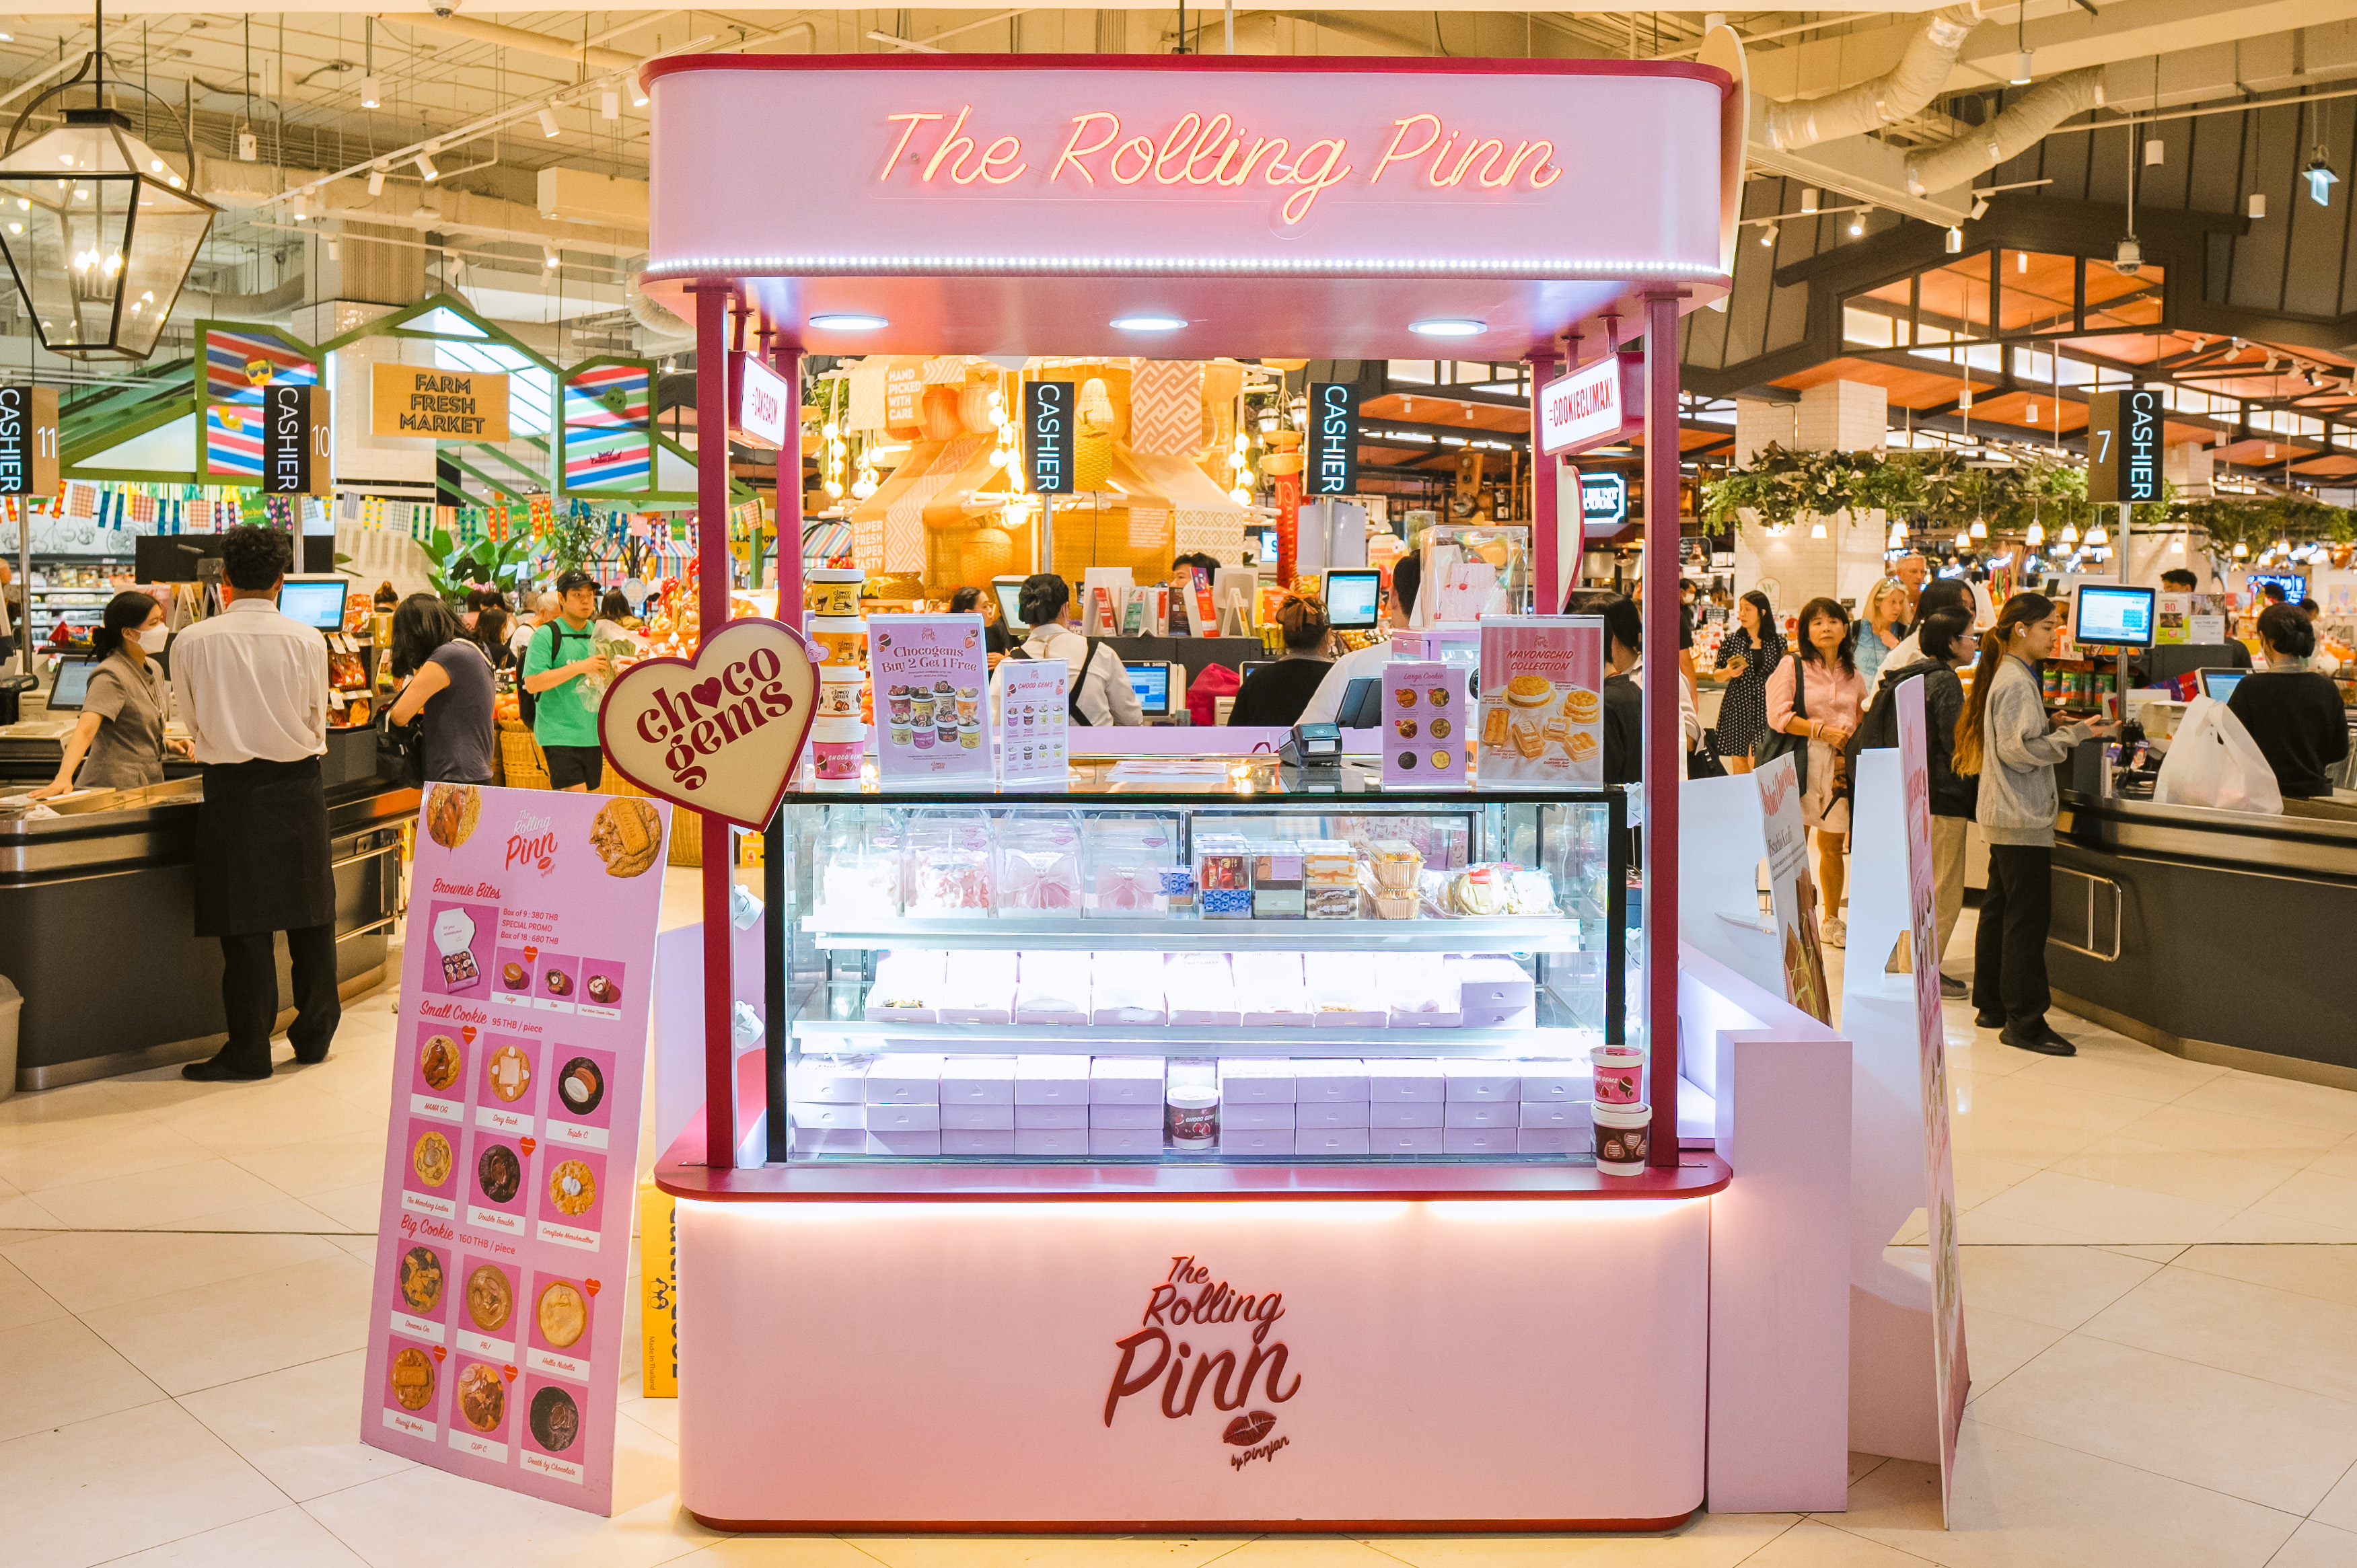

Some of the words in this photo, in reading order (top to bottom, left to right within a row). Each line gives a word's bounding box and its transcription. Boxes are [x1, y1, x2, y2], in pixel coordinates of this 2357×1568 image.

[880, 103, 1027, 184] The
[1049, 110, 1352, 226] Rolling
[1371, 112, 1562, 188] Pinn
[889, 369, 915, 381] HAND
[415, 374, 470, 394] FARM
[889, 380, 921, 395] PICKED
[410, 394, 476, 414] FRESH
[889, 396, 911, 408] WITH
[889, 407, 913, 420] CARE
[399, 413, 485, 434] MARKET
[0, 388, 22, 492] CASHIER
[37, 426, 56, 459] 11
[277, 387, 298, 492] CASHIER
[312, 424, 330, 457] 10
[1036, 383, 1060, 491] CASHIER
[1321, 385, 1348, 493] CASHIER
[2097, 429, 2111, 463] 7
[2130, 392, 2153, 499] CASHIER
[853, 521, 883, 534] SUPER
[854, 533, 883, 546] FRESH
[854, 545, 883, 558] SUPER
[855, 557, 883, 570] TASTY
[2165, 603, 2175, 611] 80
[894, 645, 964, 658] Chocogems
[1506, 650, 1574, 659] MAYONGCHID
[881, 661, 905, 673] Buy
[908, 658, 916, 669] 2
[919, 657, 939, 667] Get
[943, 659, 947, 667] 1
[950, 658, 977, 672] Free
[1510, 662, 1570, 671] COLLECTION
[1404, 673, 1422, 683] Large
[665, 681, 793, 790] gems
[519, 809, 530, 819] The
[513, 816, 552, 835] Rolling
[505, 832, 558, 871] Pinn
[432, 877, 474, 897] Brownie
[476, 882, 501, 899] Bites
[503, 908, 514, 916] Box
[515, 909, 523, 917] of
[531, 911, 544, 920] 380
[545, 913, 558, 921] THB
[502, 920, 527, 930] SPECIAL
[528, 923, 552, 932] PROMO
[501, 931, 512, 939] Box
[532, 934, 544, 942] 680
[545, 936, 558, 944] THB
[419, 999, 450, 1019] Small
[452, 1006, 487, 1024] Cookie
[492, 1017, 502, 1026] 95
[502, 1018, 517, 1029] THB
[523, 1022, 543, 1033] piece
[424, 1103, 439, 1113] MAMA
[493, 1114, 504, 1126] Sexy
[505, 1117, 518, 1125] Back
[567, 1128, 582, 1140] Triple
[583, 1131, 589, 1139] C
[478, 1212, 496, 1223] Double
[497, 1215, 515, 1227] Trouble
[400, 1214, 416, 1238] Big
[420, 1218, 454, 1240] Cookie
[459, 1233, 472, 1244] 160
[474, 1236, 489, 1248] THB
[495, 1242, 516, 1255] piece
[1168, 1255, 1210, 1284] The
[1143, 1281, 1286, 1345] Rolling
[542, 1357, 556, 1367] Hella
[556, 1359, 575, 1372] Nutella
[1103, 1327, 1302, 1428] Pinn
[395, 1417, 410, 1430] Biscoff
[482, 1445, 487, 1453] C
[528, 1456, 542, 1467] Death
[542, 1460, 550, 1471] by
[550, 1463, 575, 1476] Chocolate
[1231, 1454, 1243, 1472] by
